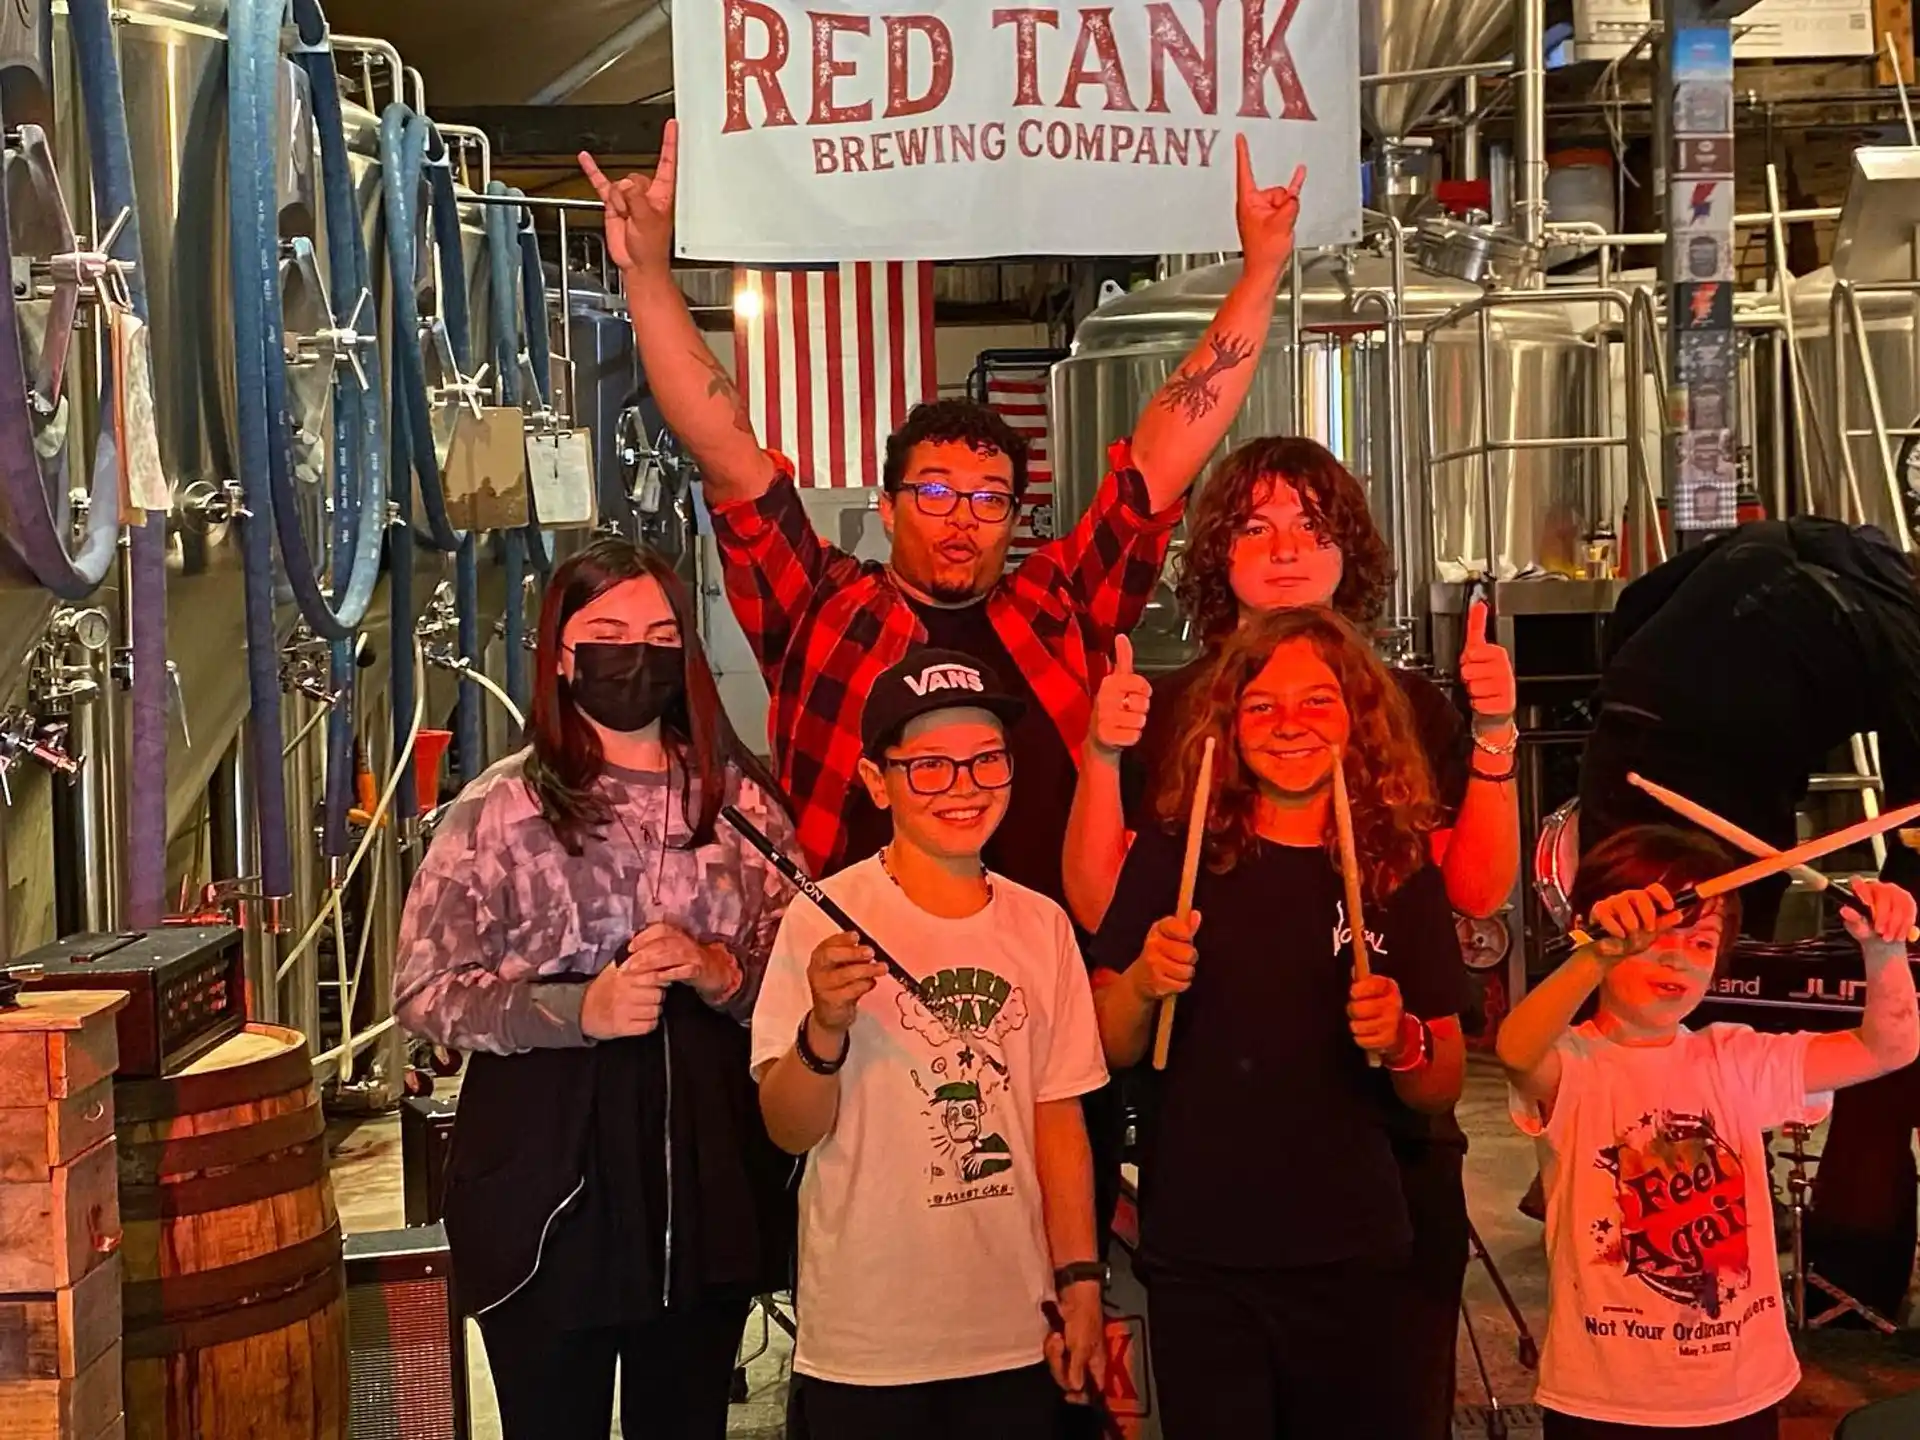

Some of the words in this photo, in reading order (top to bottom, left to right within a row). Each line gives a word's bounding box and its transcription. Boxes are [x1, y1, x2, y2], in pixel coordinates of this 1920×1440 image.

[721, 0, 954, 134] RED
[992, 0, 1318, 120] TANK
[812, 121, 1005, 174] BREWING
[1017, 118, 1220, 167] COMPANY
[903, 663, 984, 696] VANS
[794, 869, 825, 904] NOVA
[920, 966, 1012, 1005] GREEN
[1624, 1145, 1731, 1218] Feel
[1585, 1316, 1617, 1336] Not
[1623, 1318, 1666, 1341] Your
[1673, 1320, 1742, 1341] Ordinary
